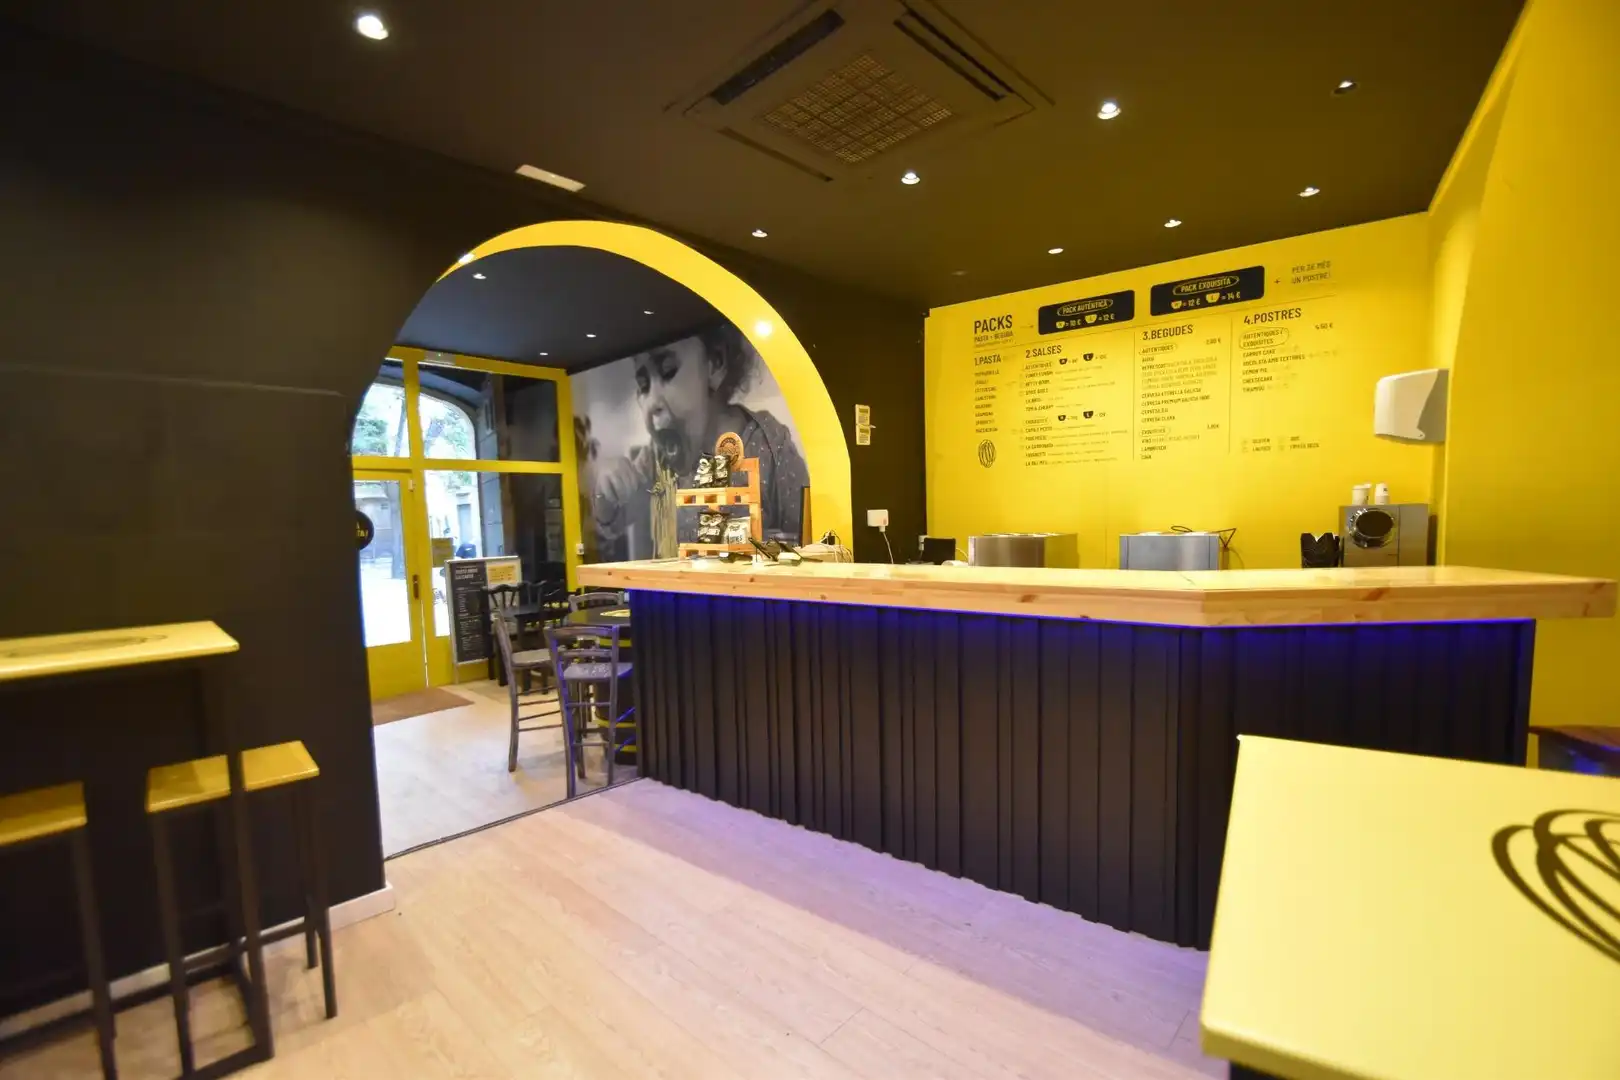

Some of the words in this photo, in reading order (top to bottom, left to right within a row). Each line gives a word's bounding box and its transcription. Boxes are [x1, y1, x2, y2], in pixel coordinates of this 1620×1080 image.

[1180, 283, 1197, 293] PACK
[1198, 277, 1231, 290] EXQUISITA
[1291, 276, 1302, 285] UN
[1061, 305, 1077, 316] PACK
[1243, 307, 1302, 325] 4.POSTRES
[974, 314, 1013, 335] PACKS
[1142, 324, 1194, 341] 3.BEGUDES
[1025, 344, 1063, 359] 2.SALSES
[974, 353, 1002, 367] 1.PASTA
